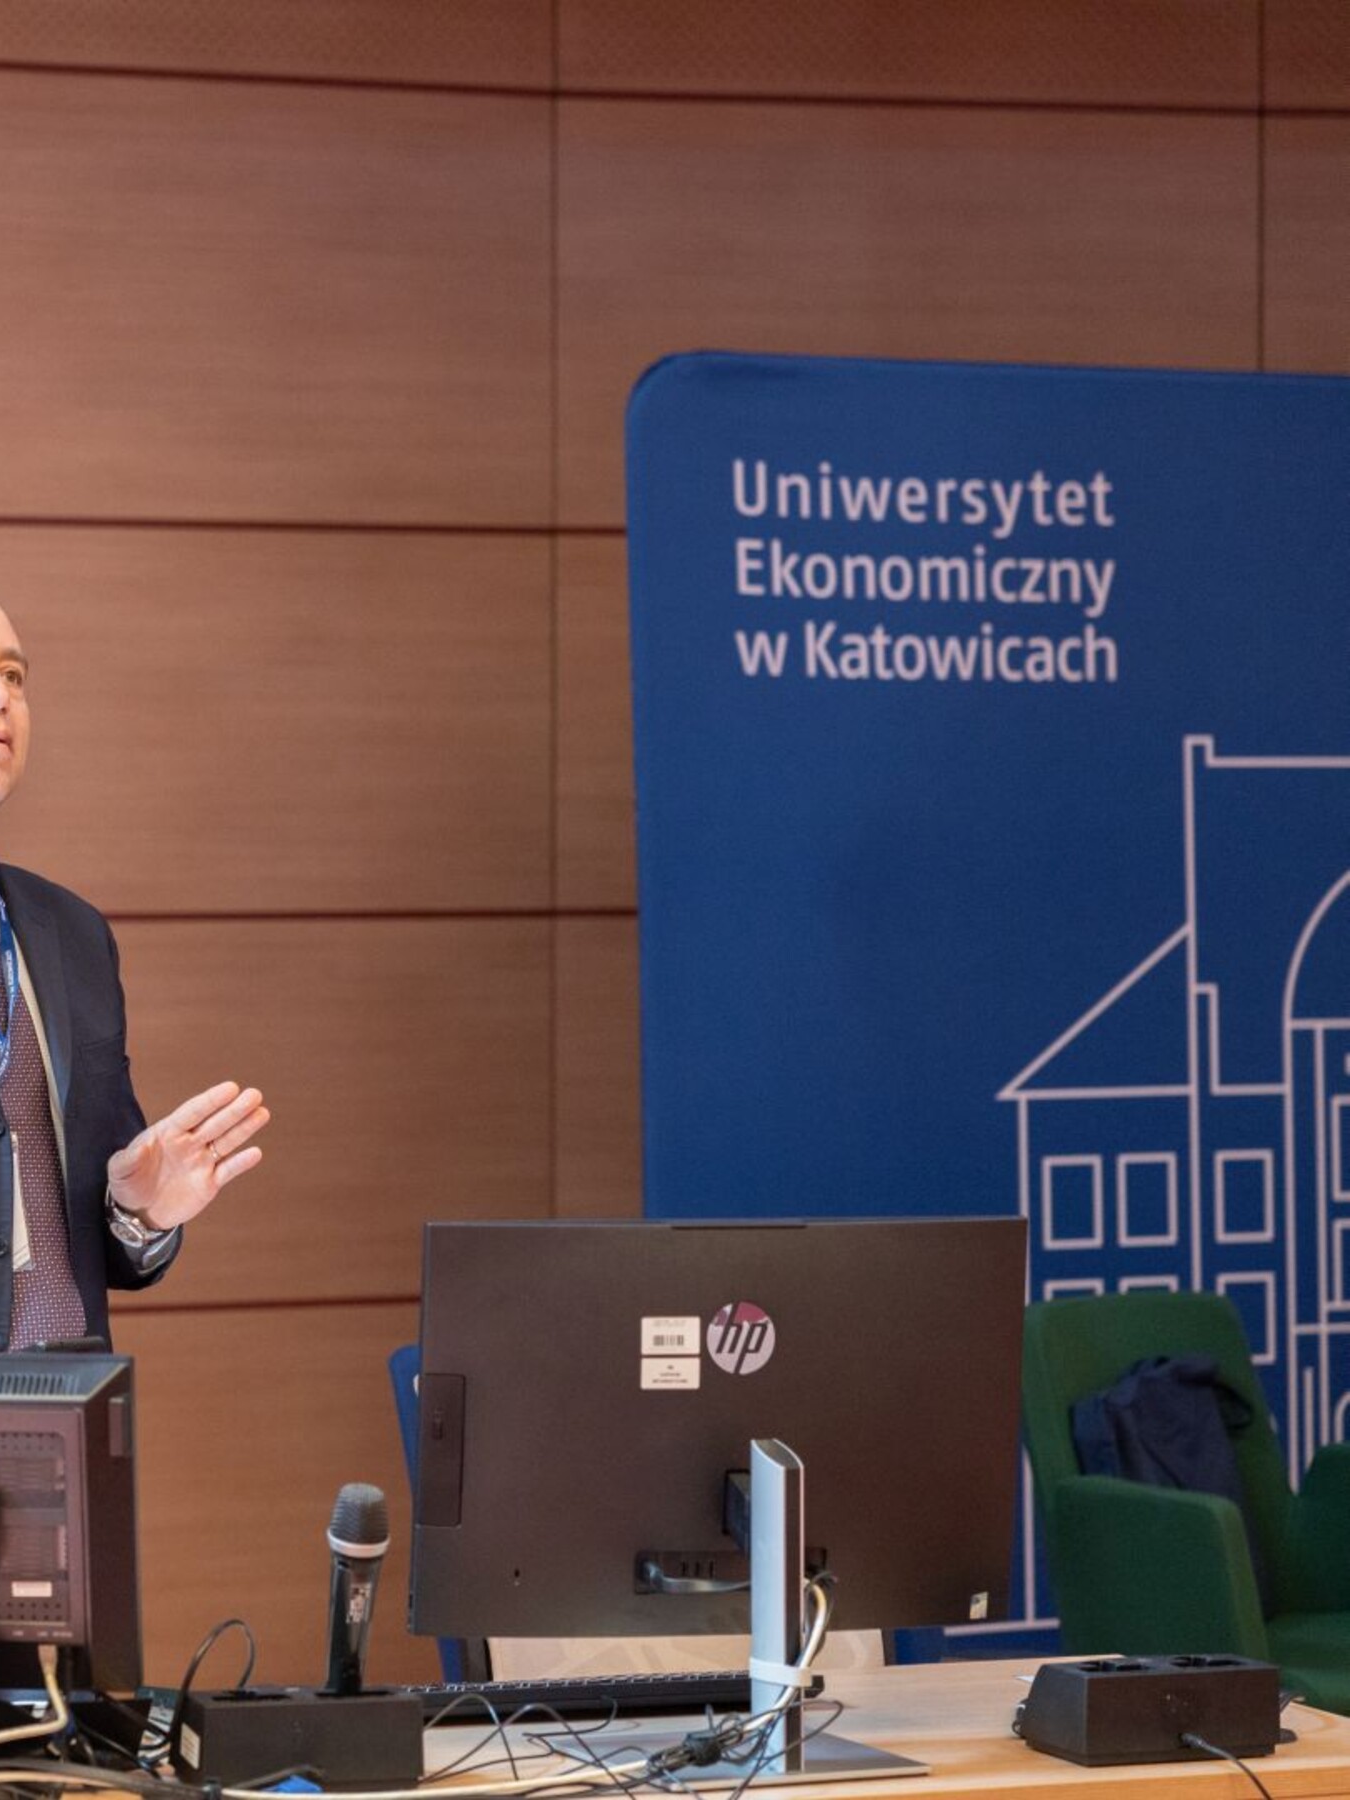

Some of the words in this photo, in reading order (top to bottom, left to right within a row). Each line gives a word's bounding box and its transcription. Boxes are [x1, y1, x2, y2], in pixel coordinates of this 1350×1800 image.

[733, 458, 1115, 539] Uniwersytet
[735, 537, 1116, 618] Ekonomiczny
[735, 630, 789, 678] w
[804, 620, 1119, 683] Katowicach
[714, 1302, 769, 1375] hp
